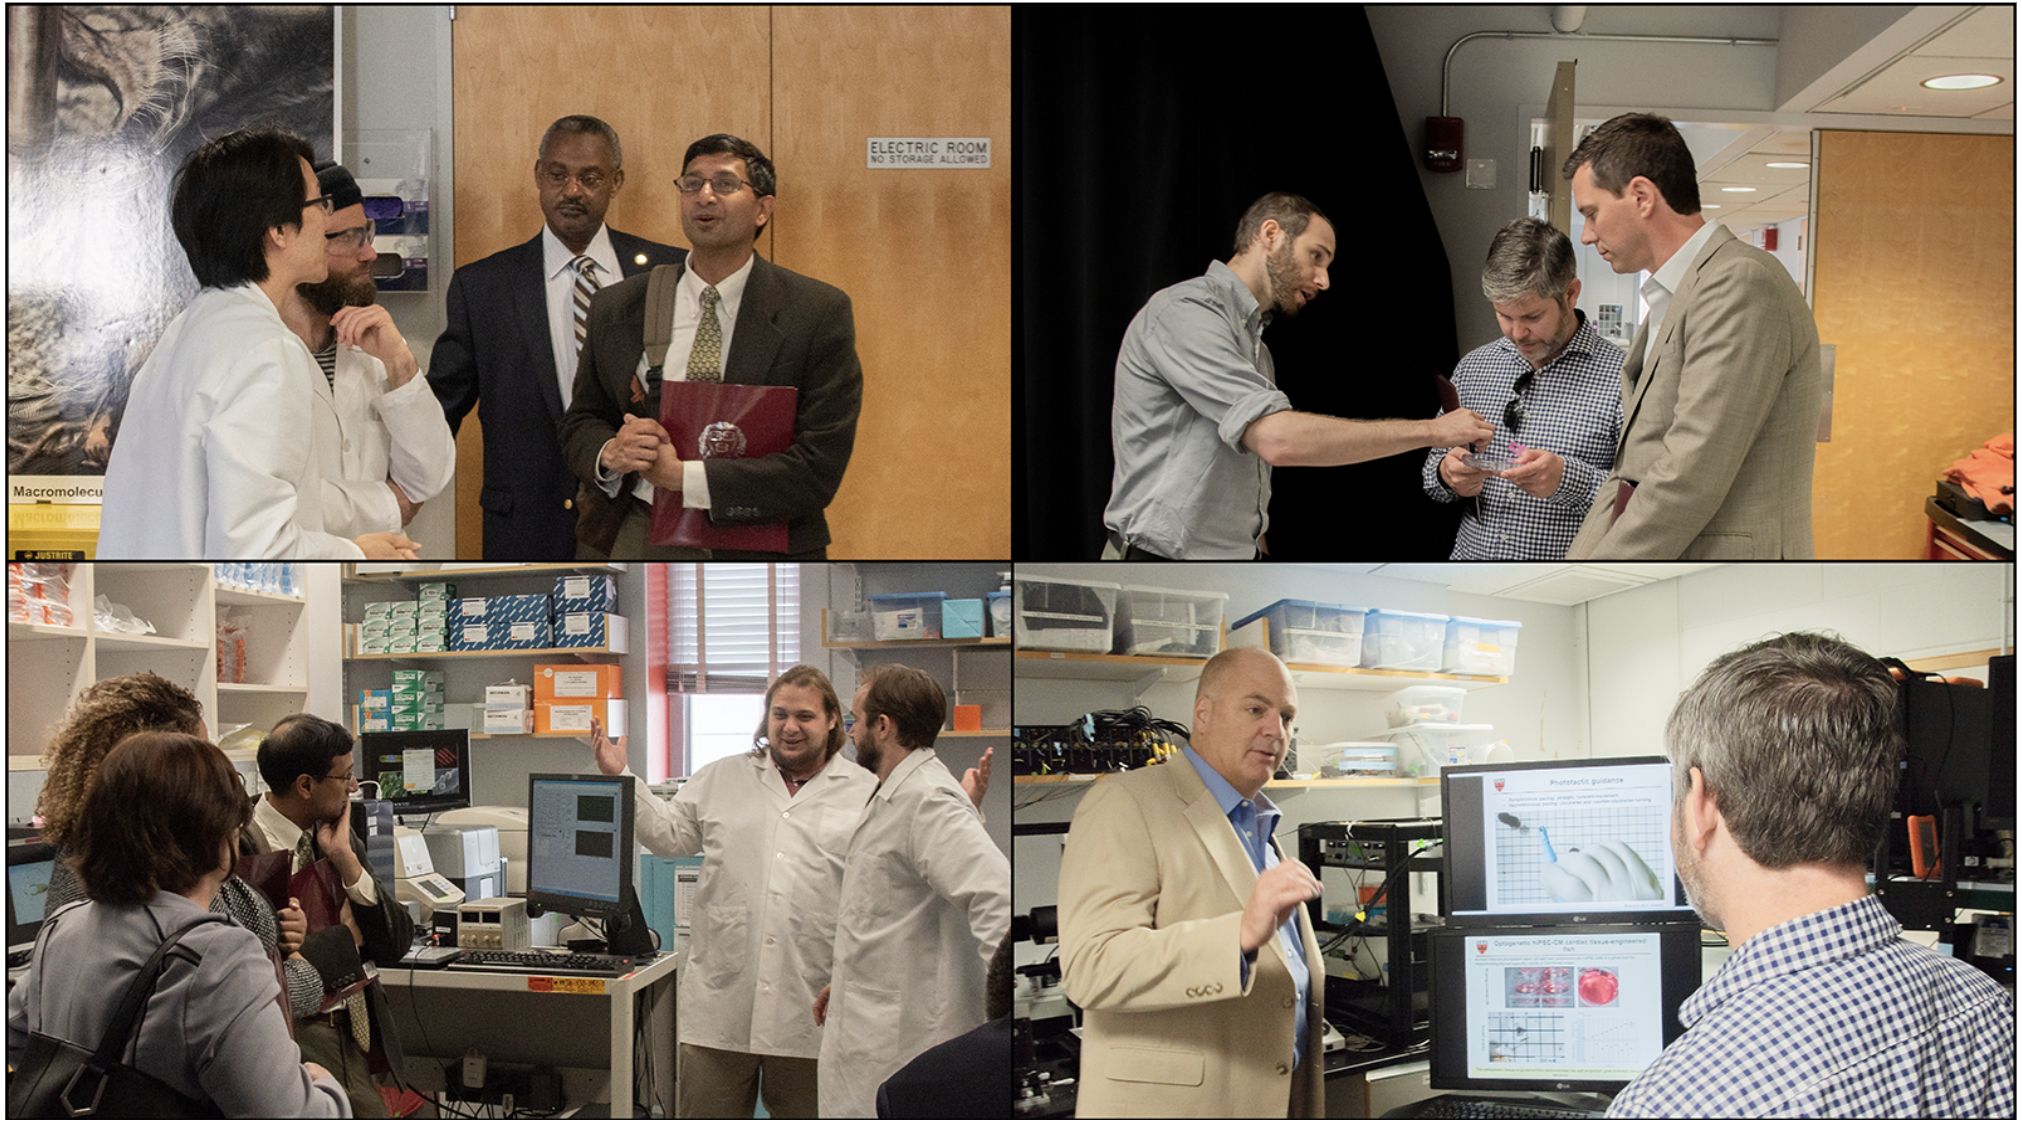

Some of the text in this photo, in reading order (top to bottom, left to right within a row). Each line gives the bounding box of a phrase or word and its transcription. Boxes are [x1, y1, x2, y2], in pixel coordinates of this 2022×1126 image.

[870, 141, 988, 154] ELECTRIC ROOM
[870, 154, 988, 164] NO STORAGE ALLOWED
[13, 485, 103, 498] Macromolecu
[34, 551, 73, 560] JUSTRITE
[1592, 777, 1624, 786] guidance
